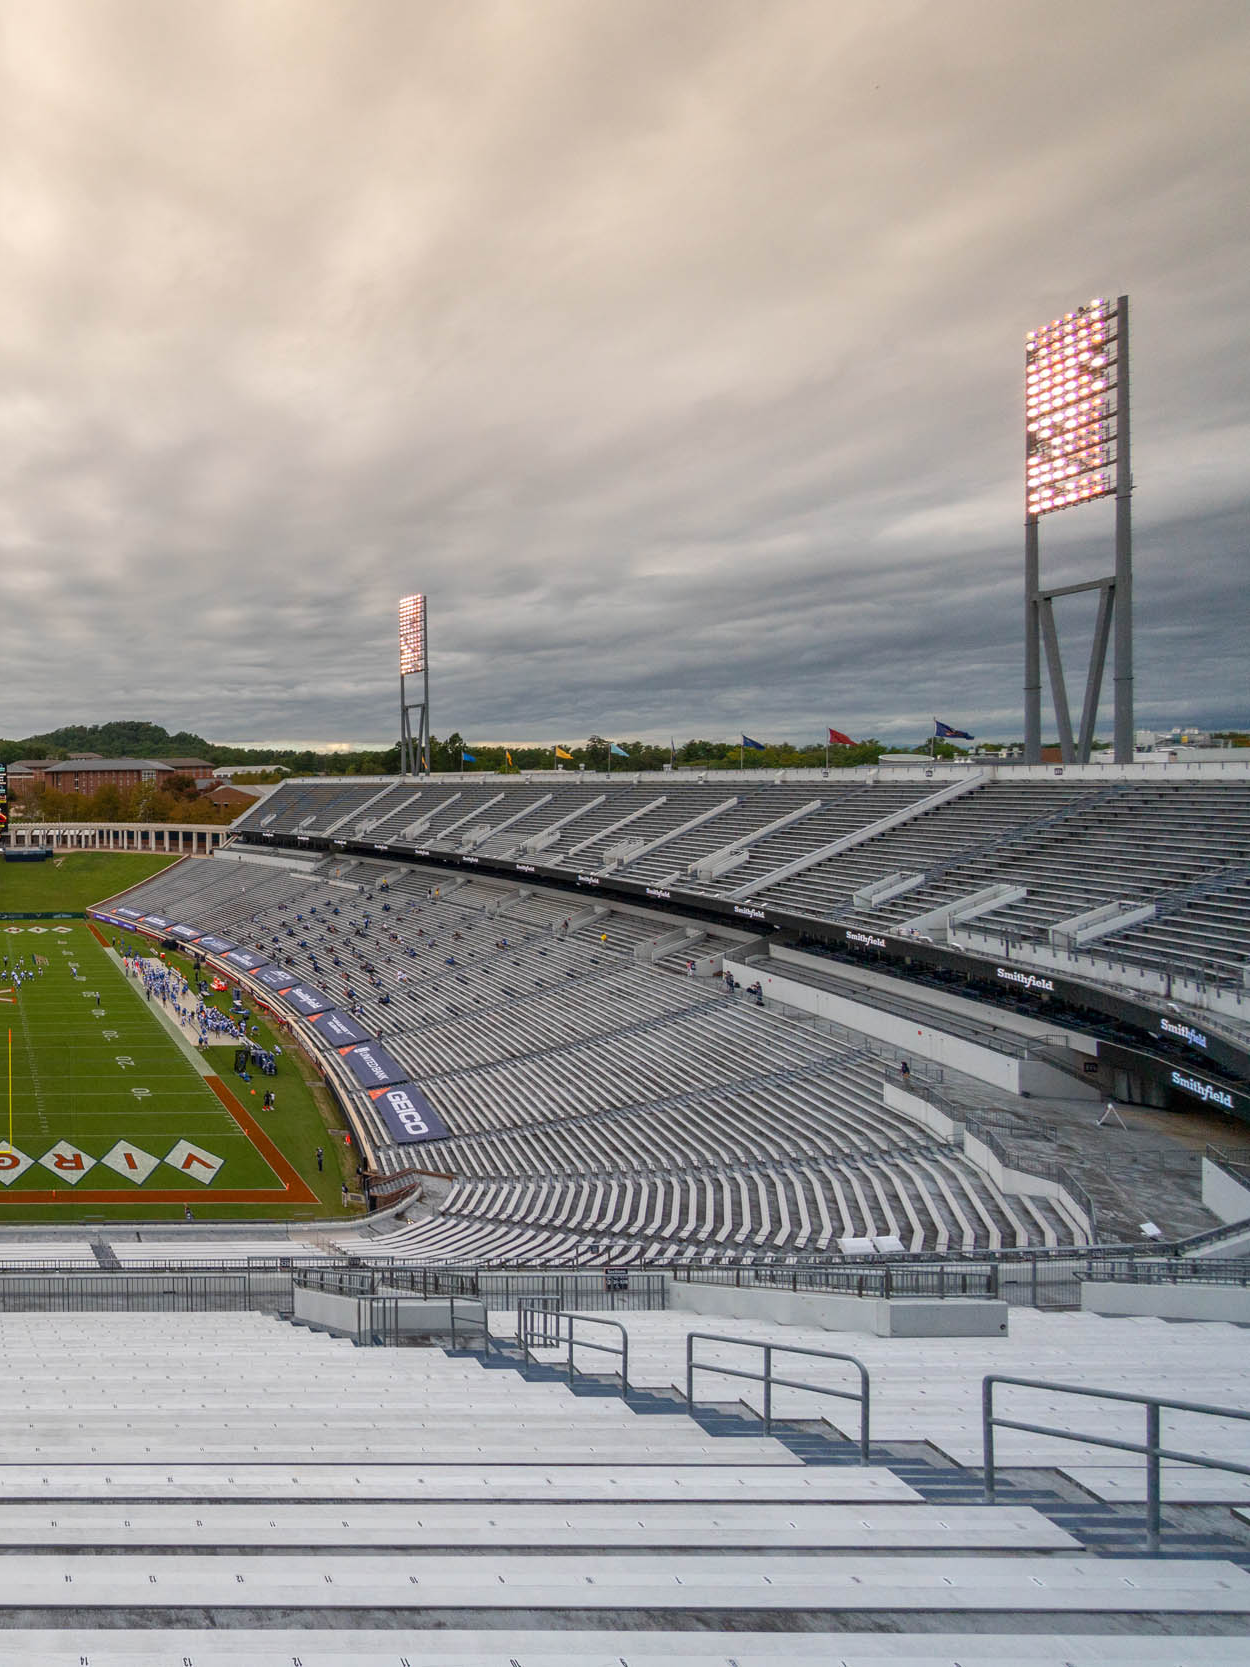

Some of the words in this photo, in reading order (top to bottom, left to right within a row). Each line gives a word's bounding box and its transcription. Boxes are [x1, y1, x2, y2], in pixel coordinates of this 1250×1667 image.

[646, 887, 670, 898] Smithfield
[734, 906, 765, 919] Smithfield
[846, 930, 886, 948] Smithfield
[997, 967, 1054, 991] Smithfield
[1161, 1019, 1207, 1049] Smithfield
[360, 1049, 379, 1068] UNITED
[371, 1065, 390, 1081] BANK
[1171, 1071, 1234, 1109] Smithfield
[386, 1090, 429, 1135] GEICO
